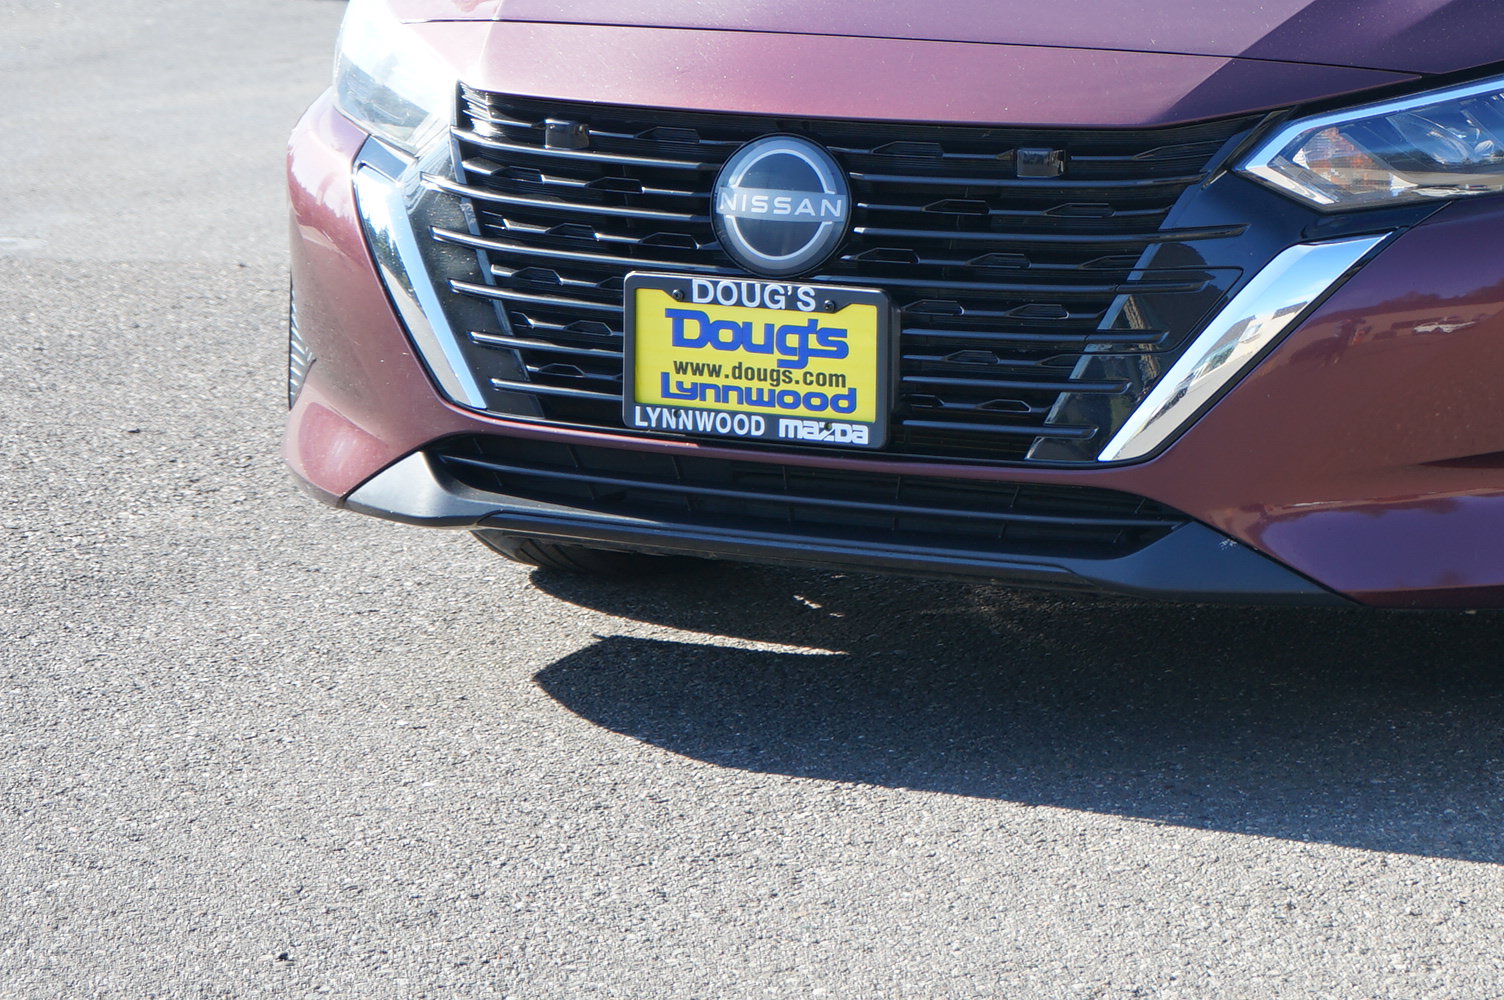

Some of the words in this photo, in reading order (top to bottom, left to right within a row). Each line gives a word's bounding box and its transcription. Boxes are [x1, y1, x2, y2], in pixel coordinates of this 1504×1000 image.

[717, 190, 843, 217] NISSAN
[691, 278, 817, 312] DOUG'S
[664, 308, 849, 370] Doug's
[673, 360, 847, 388] www.dougs.com
[660, 372, 857, 414] Lynnwood
[634, 405, 766, 436] LYNNWOOD
